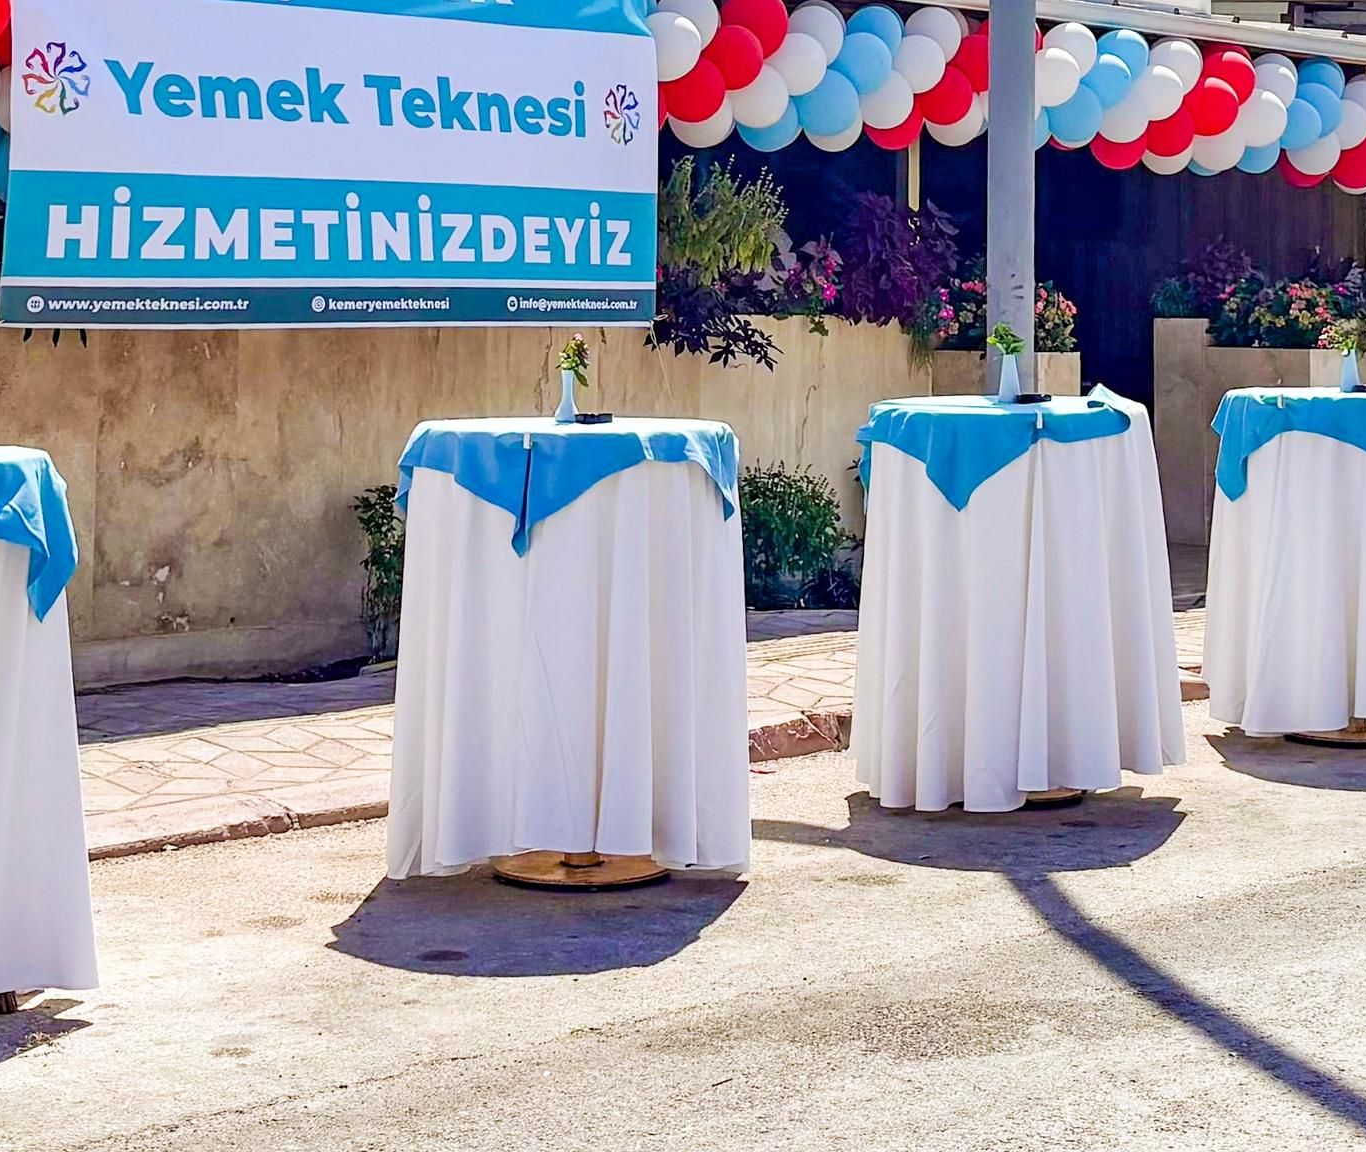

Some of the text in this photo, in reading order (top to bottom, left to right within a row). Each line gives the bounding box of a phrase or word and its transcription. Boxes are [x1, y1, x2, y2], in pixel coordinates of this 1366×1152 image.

[103, 58, 587, 139] Yemek Teknesi
[45, 185, 633, 267] HİZMETİNİZDEYİZ
[47, 296, 250, 312] www.yemekteknesi.com.tr
[328, 296, 451, 312] kemeryemekteknesi
[519, 296, 639, 311] info@yemekteknesi.com.tr
